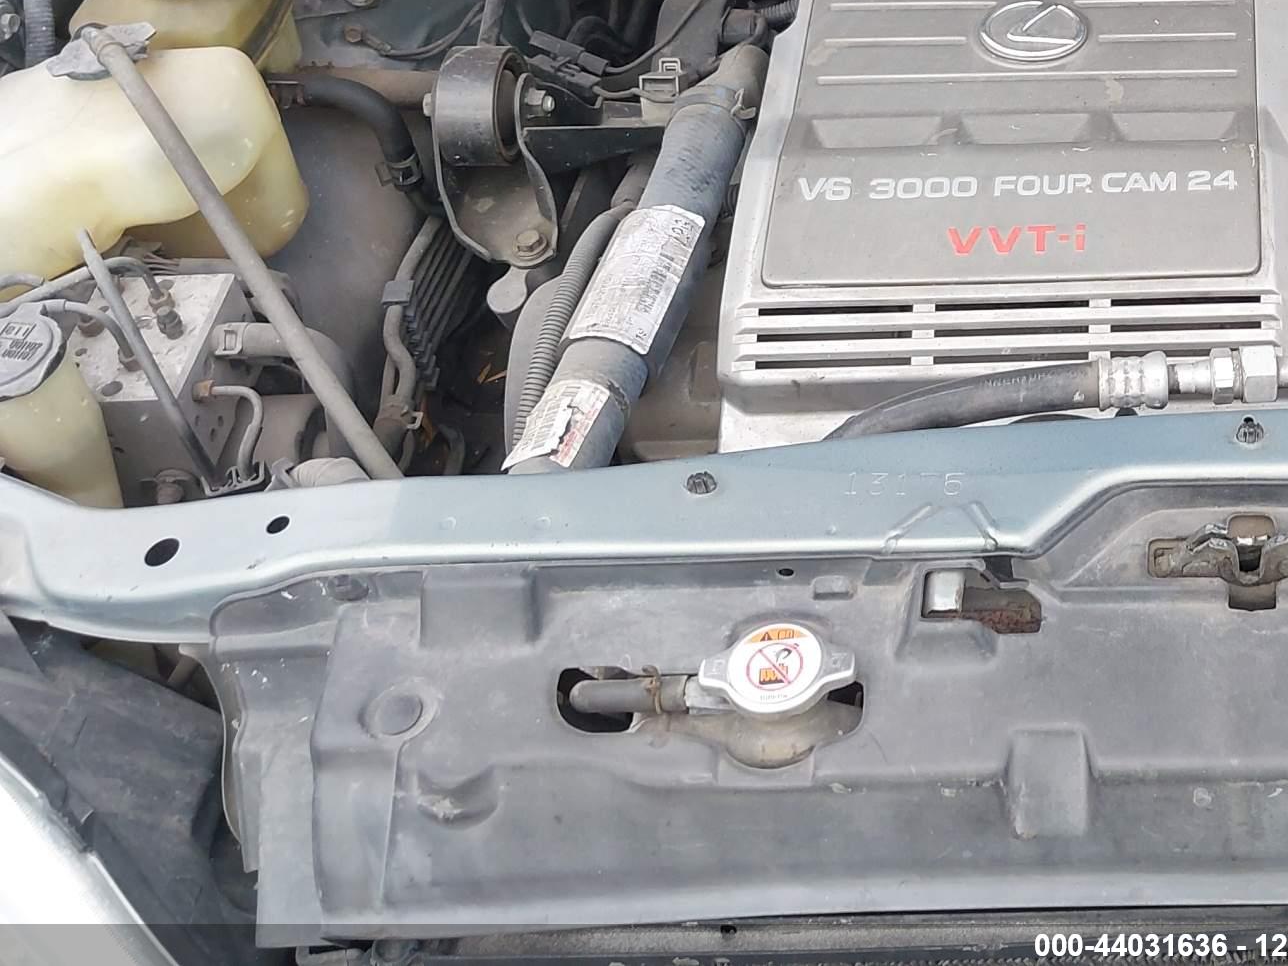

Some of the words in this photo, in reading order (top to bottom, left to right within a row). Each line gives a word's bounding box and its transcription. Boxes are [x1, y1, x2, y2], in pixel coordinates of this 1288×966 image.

[798, 177, 852, 201] V6
[869, 175, 978, 200] 3000
[993, 173, 1093, 196] FOUR
[1101, 171, 1177, 193] CAM
[1187, 170, 1238, 192] 24
[947, 224, 1088, 255] VVT-i
